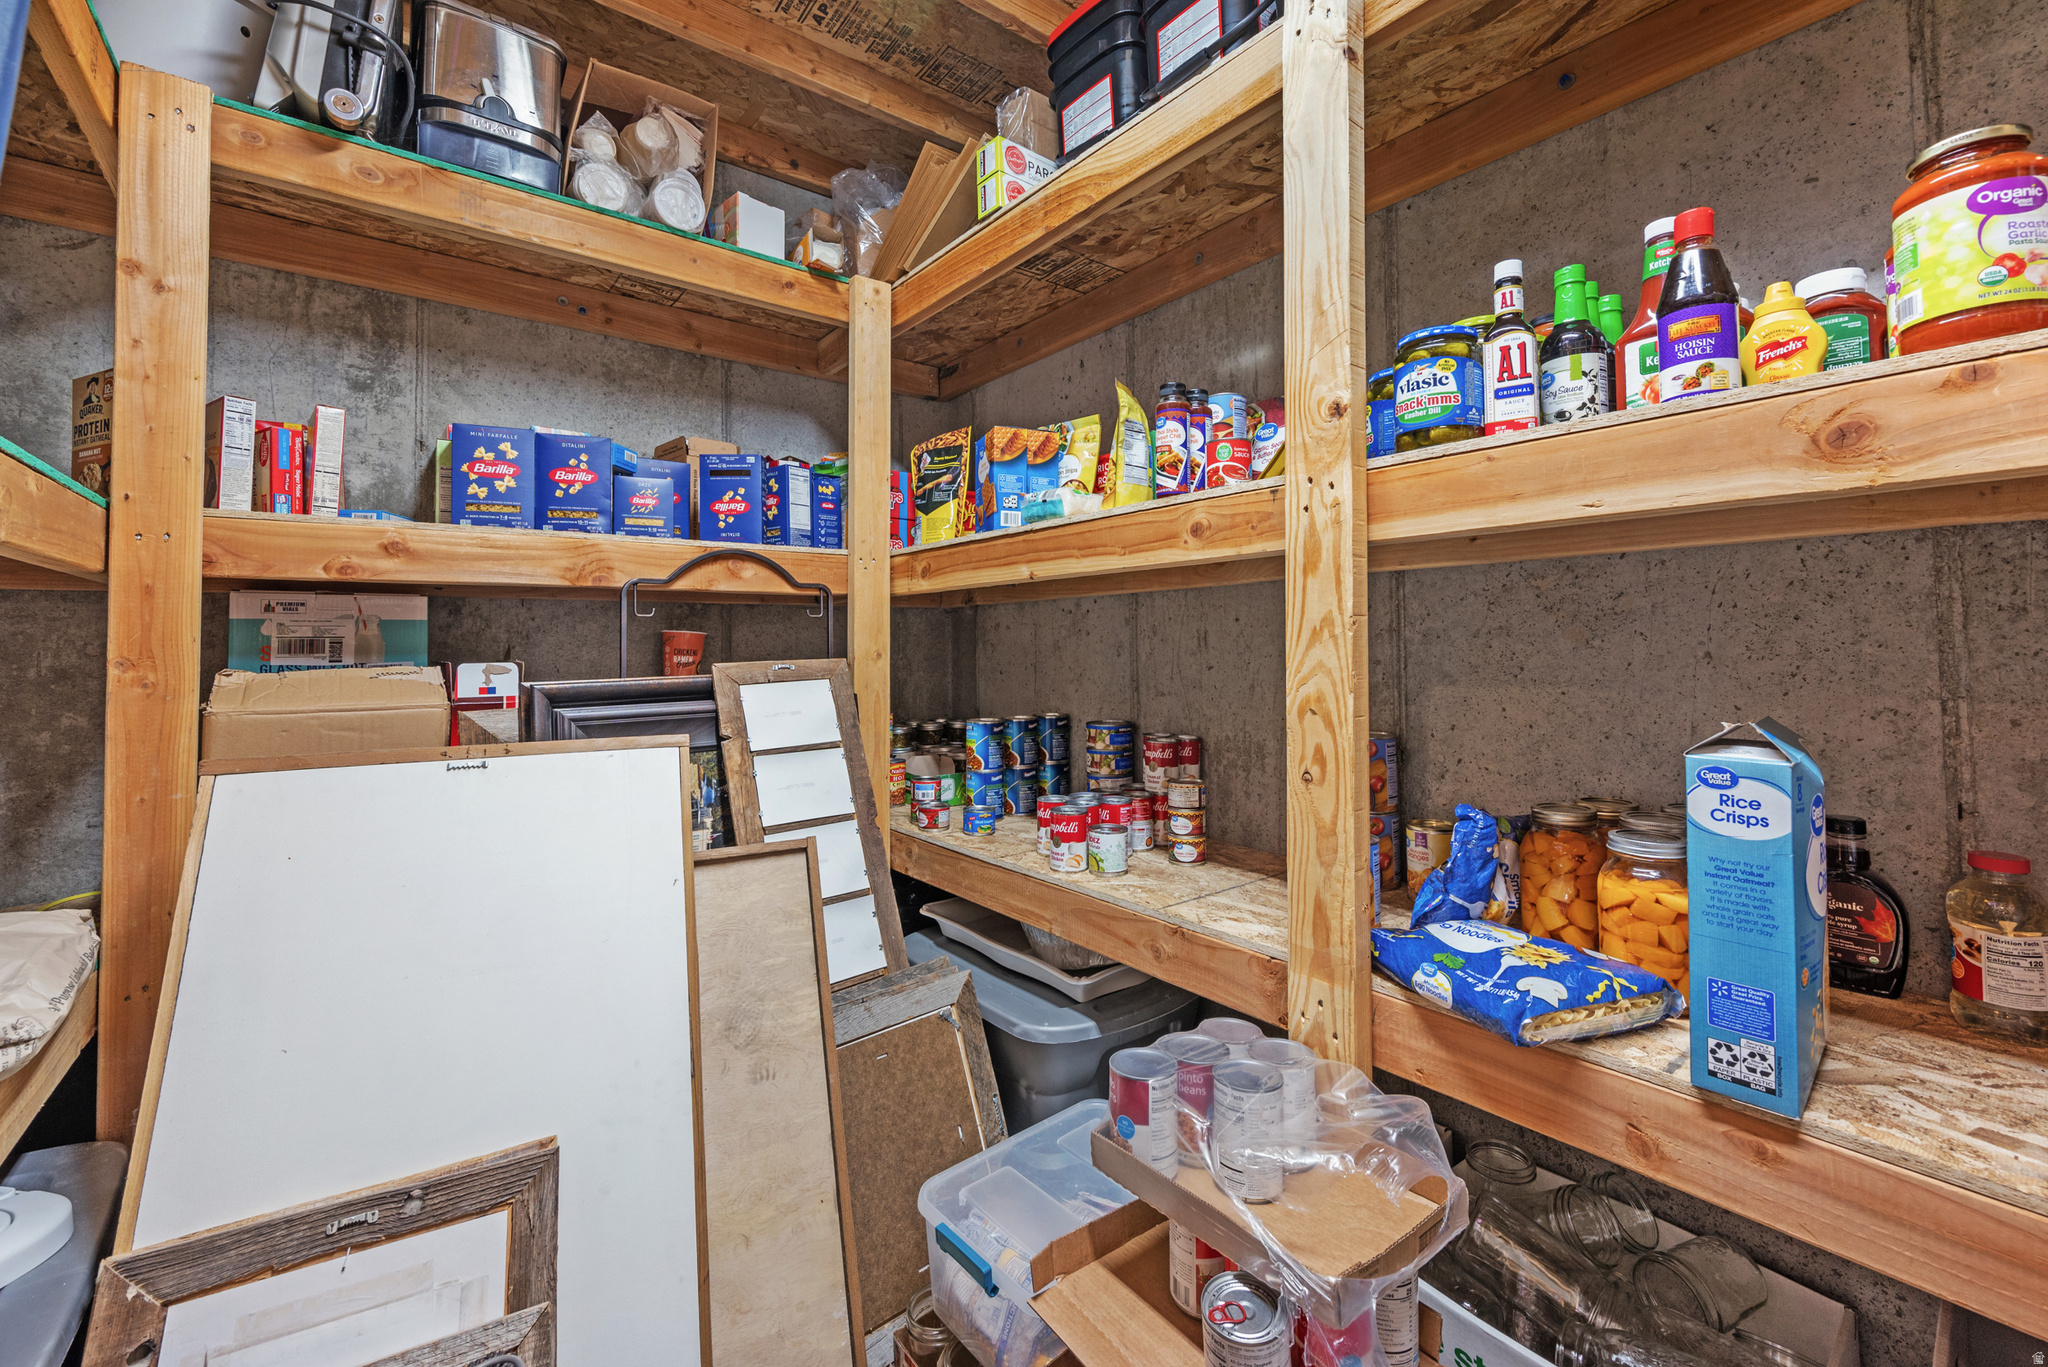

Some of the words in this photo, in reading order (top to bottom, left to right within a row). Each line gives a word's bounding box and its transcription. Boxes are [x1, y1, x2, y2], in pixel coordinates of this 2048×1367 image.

[1950, 132, 1974, 144] CLOSE
[1028, 161, 1054, 178] PAR
[1976, 184, 2044, 204] Organic
[2008, 227, 2047, 240] Garlic
[2009, 237, 2034, 246] Pasta
[1649, 257, 1672, 271] Ketch
[1978, 292, 1991, 300] NET
[1674, 337, 1715, 352] HOISIN
[1677, 346, 1714, 359] SAUCE
[1758, 340, 1802, 364] French's
[1399, 373, 1450, 395] vlasic
[1499, 387, 1531, 396] ORIGINAL
[1545, 390, 1558, 400] Soy
[1558, 385, 1584, 394] Sauce
[1505, 398, 1525, 406] SAUCE
[79, 404, 103, 419] QUAKER
[1404, 409, 1427, 420] Kosher
[1429, 406, 1441, 414] Dill
[73, 418, 110, 439] PROTEIN
[1258, 426, 1274, 436] Great
[487, 432, 518, 440] FARFALLE
[474, 463, 514, 475] Barilla
[555, 471, 591, 481] Barilla
[714, 502, 746, 512] Barilla
[1700, 769, 1731, 781] Great
[1708, 778, 1732, 786] Value
[1719, 793, 1762, 810] Rice
[1710, 808, 1770, 828] Crisps
[1051, 822, 1078, 834] mpbell's
[1708, 856, 1726, 866] Why
[1727, 859, 1741, 867] not
[1743, 860, 1755, 869] try
[1756, 863, 1770, 871] our
[1714, 865, 1738, 874] Great
[1739, 869, 1764, 878] Value
[1704, 871, 1731, 881] Instant
[1733, 875, 1775, 888] Oatmeal?
[1720, 882, 1749, 893] comes
[1705, 887, 1733, 899] variety
[1734, 891, 1743, 899] of
[1745, 893, 1775, 905] flavors.
[1724, 898, 1750, 909] made
[1751, 902, 1770, 912] with
[1828, 899, 1864, 911] ganic
[1706, 903, 1731, 913] whole
[1732, 908, 1756, 919] grain
[1757, 912, 1775, 921] oats
[1702, 909, 1719, 918] and
[1736, 917, 1758, 928] great
[1760, 922, 1780, 931] way
[1837, 922, 1857, 930] syrup
[1452, 926, 1504, 943] Noodles
[1706, 918, 1715, 926] to
[1717, 920, 1734, 929] start
[1735, 924, 1754, 934] your
[1756, 927, 1775, 938] day.
[1987, 936, 2022, 946] Nutrition
[1987, 956, 2021, 966] Calories
[1455, 970, 1466, 979] NET
[1414, 980, 1427, 992] Egg
[1426, 987, 1448, 1003] Noodles
[1748, 988, 1772, 999] Quality.
[1748, 994, 1765, 1002] Price.
[1731, 994, 1768, 1008] Guaranteed.
[1178, 1071, 1204, 1086] pinto
[1713, 1065, 1736, 1078] PAPER
[1743, 1074, 1774, 1088] PLASTIC
[1717, 1073, 1733, 1083] BOX
[1750, 1082, 1766, 1093] BAG
[1178, 1084, 1207, 1096] beans
